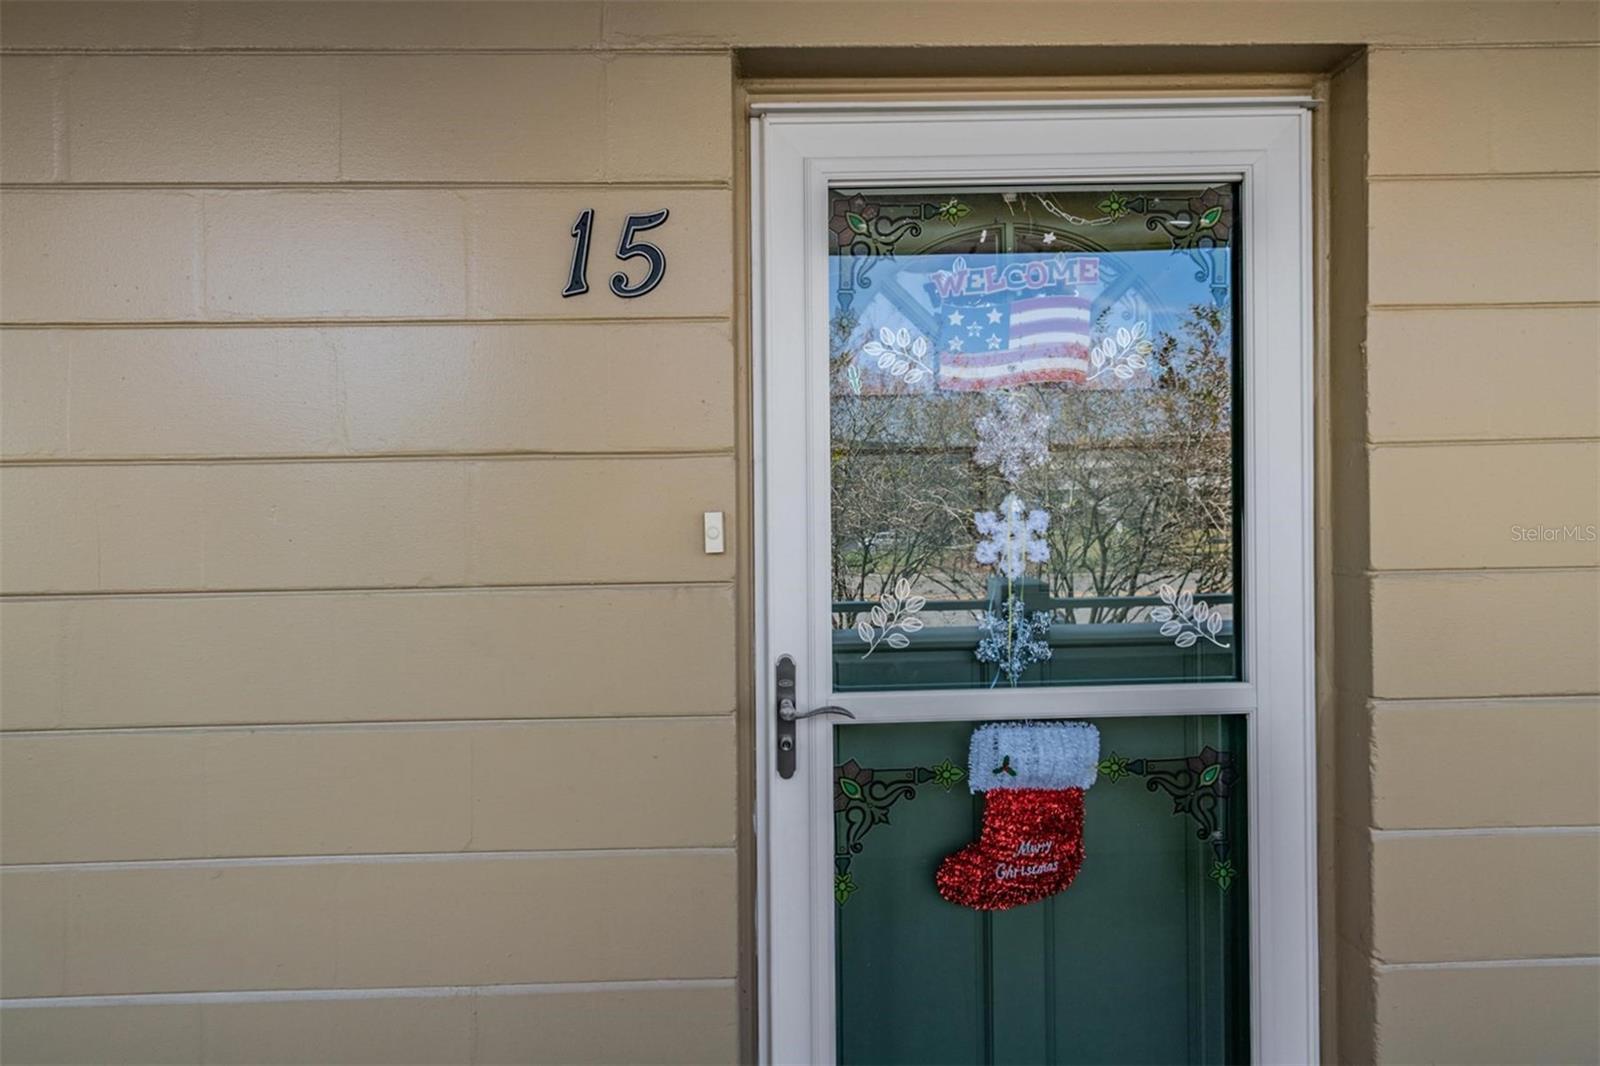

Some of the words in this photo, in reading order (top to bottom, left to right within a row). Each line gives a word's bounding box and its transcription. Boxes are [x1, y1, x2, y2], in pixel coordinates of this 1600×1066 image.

[562, 208, 669, 298] 15
[931, 256, 1100, 298] WELCOME
[1016, 840, 1052, 856] Merry
[995, 861, 1059, 879] Christmas
